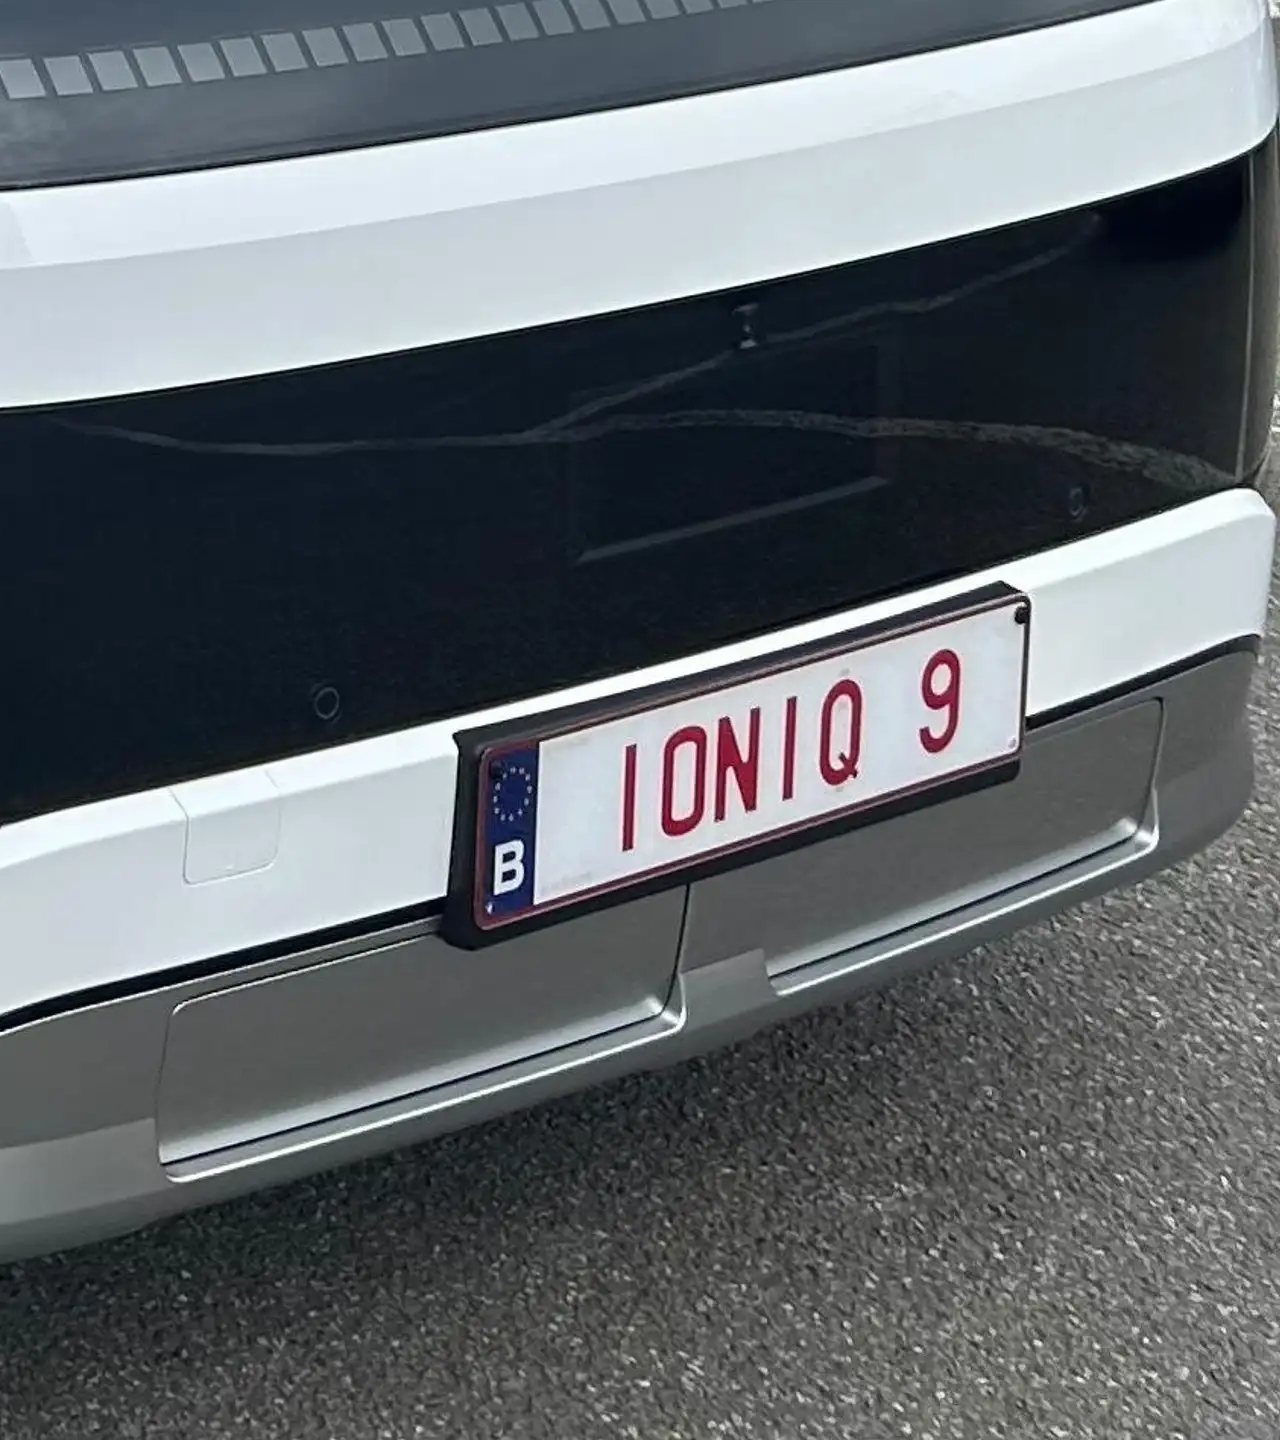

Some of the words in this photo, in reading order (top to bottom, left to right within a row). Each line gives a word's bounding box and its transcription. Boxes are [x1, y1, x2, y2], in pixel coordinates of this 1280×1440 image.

[621, 678, 863, 853] IONIQ
[918, 648, 961, 754] 9
[493, 839, 526, 897] B
